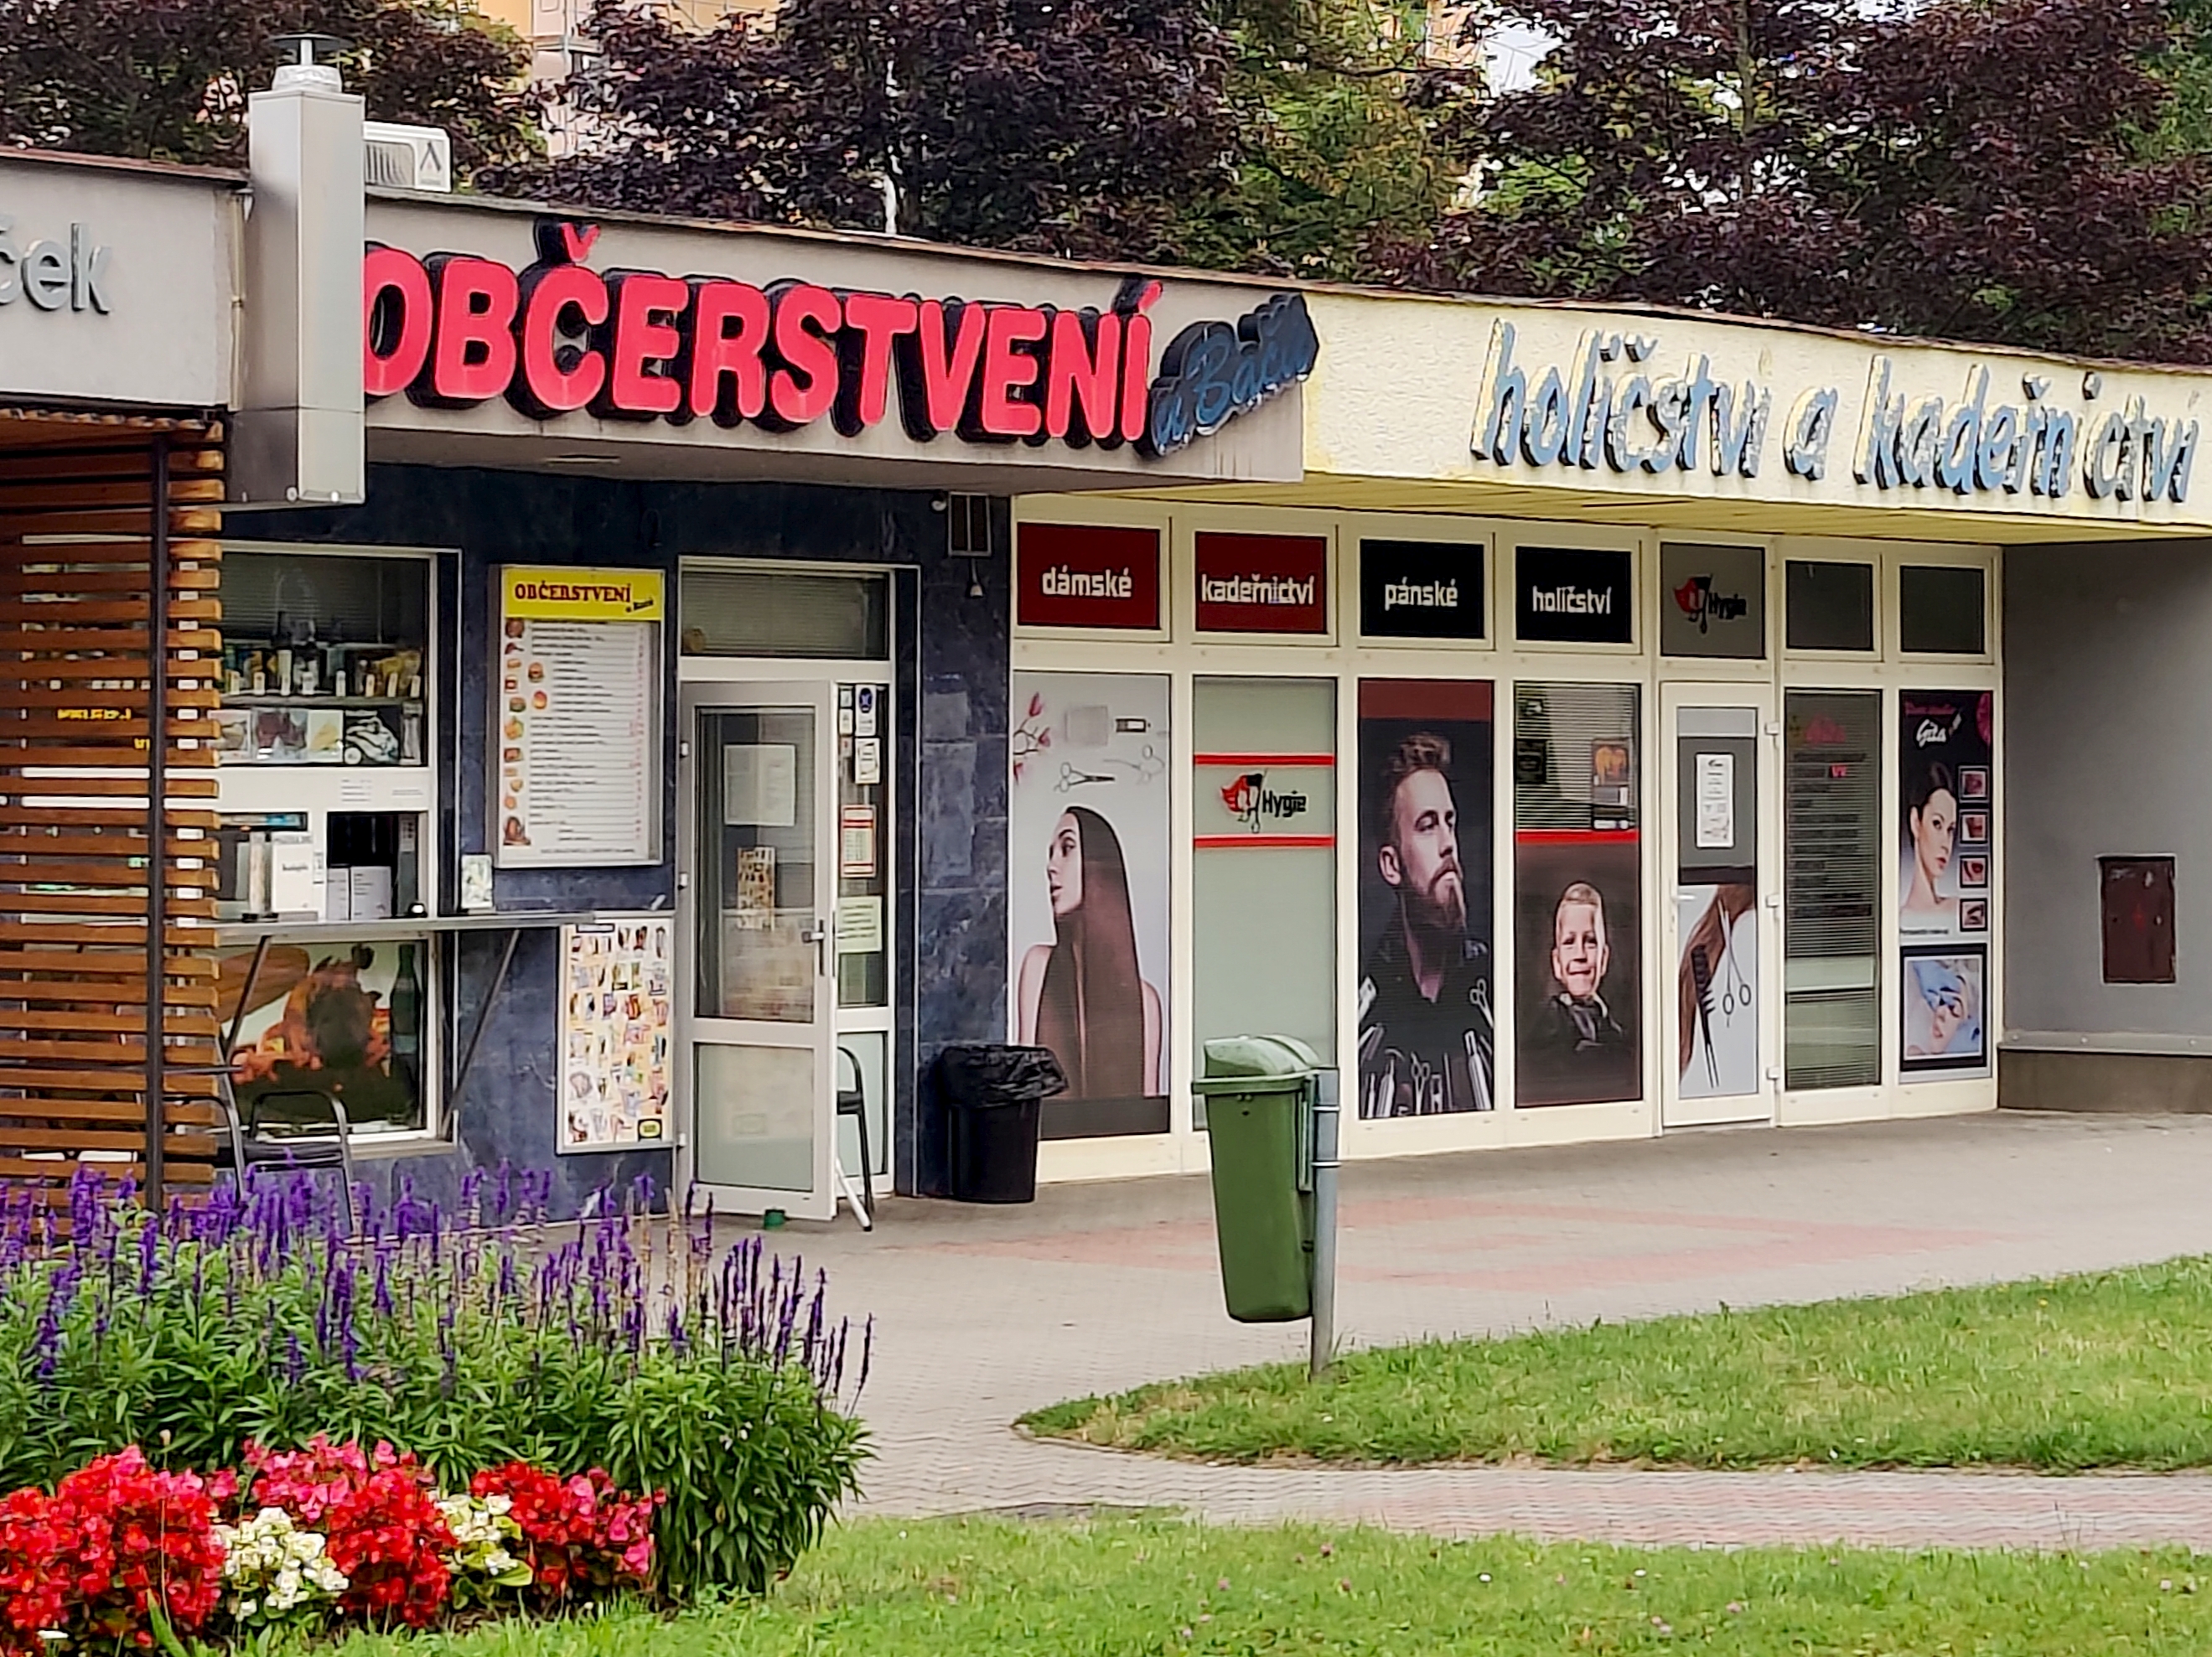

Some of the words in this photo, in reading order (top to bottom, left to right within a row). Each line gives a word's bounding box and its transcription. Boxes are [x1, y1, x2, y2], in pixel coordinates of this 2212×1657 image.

[364, 220, 1163, 446] OBČERSTVENÍ
[1783, 386, 1838, 481] a
[1042, 564, 1132, 598] dámské
[1201, 573, 1315, 605] kadeřnictví
[1384, 576, 1458, 612] pánské
[1532, 585, 1613, 614] holičství
